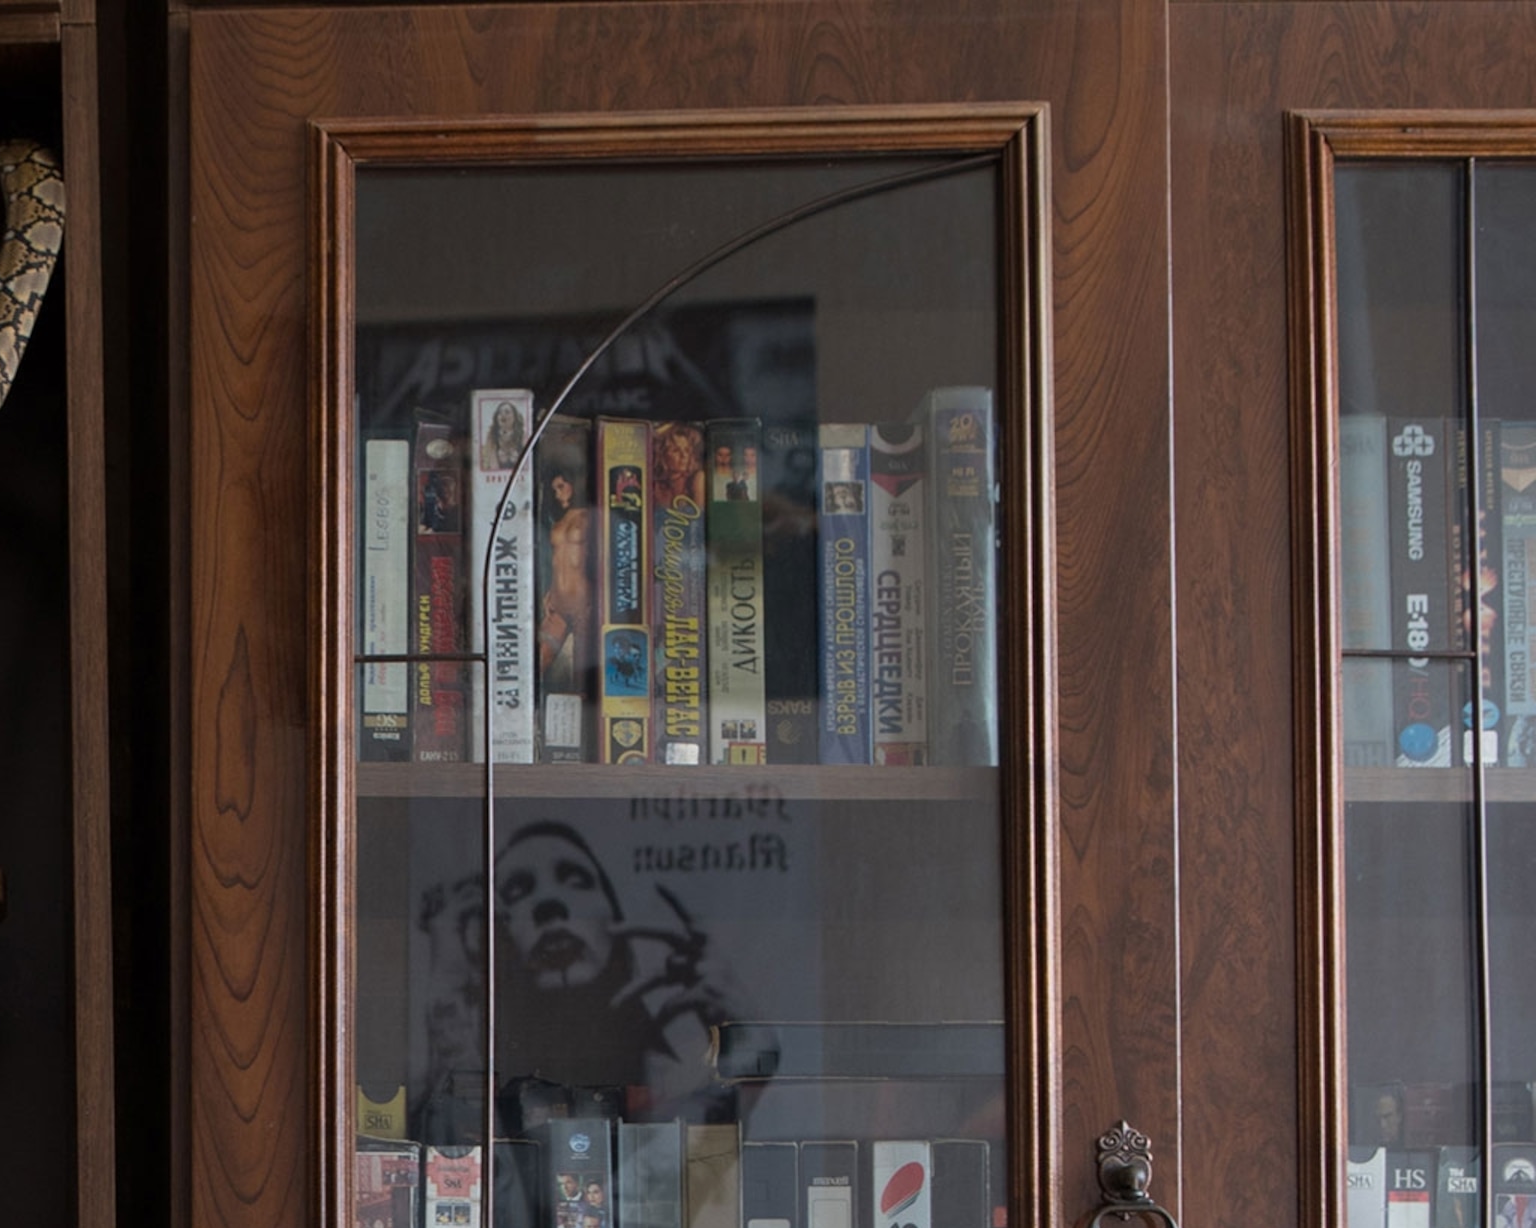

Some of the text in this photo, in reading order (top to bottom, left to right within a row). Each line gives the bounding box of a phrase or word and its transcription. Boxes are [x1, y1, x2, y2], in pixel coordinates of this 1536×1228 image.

[615, 518, 638, 613] СХВАТКА
[1406, 460, 1424, 560] SAMSUNG
[492, 537, 519, 682] ЖЕНЩИНЫ
[654, 494, 702, 736] Покидая ЛАС-ВЕГАС
[730, 556, 761, 674] ДИКОСТЬ
[835, 537, 858, 734] ВЗРЫВ ИЗ ПРОШЛОГО
[873, 570, 902, 734] СЕРДЦЕЕДКИ
[950, 532, 974, 686] ПРОКЛЯТЫЙ
[1451, 524, 1463, 673] ВОЗВРАЩАЕТЯ
[768, 699, 812, 714] RAKS
[1395, 1169, 1426, 1189] HS
[1448, 1178, 1476, 1192] VHS
